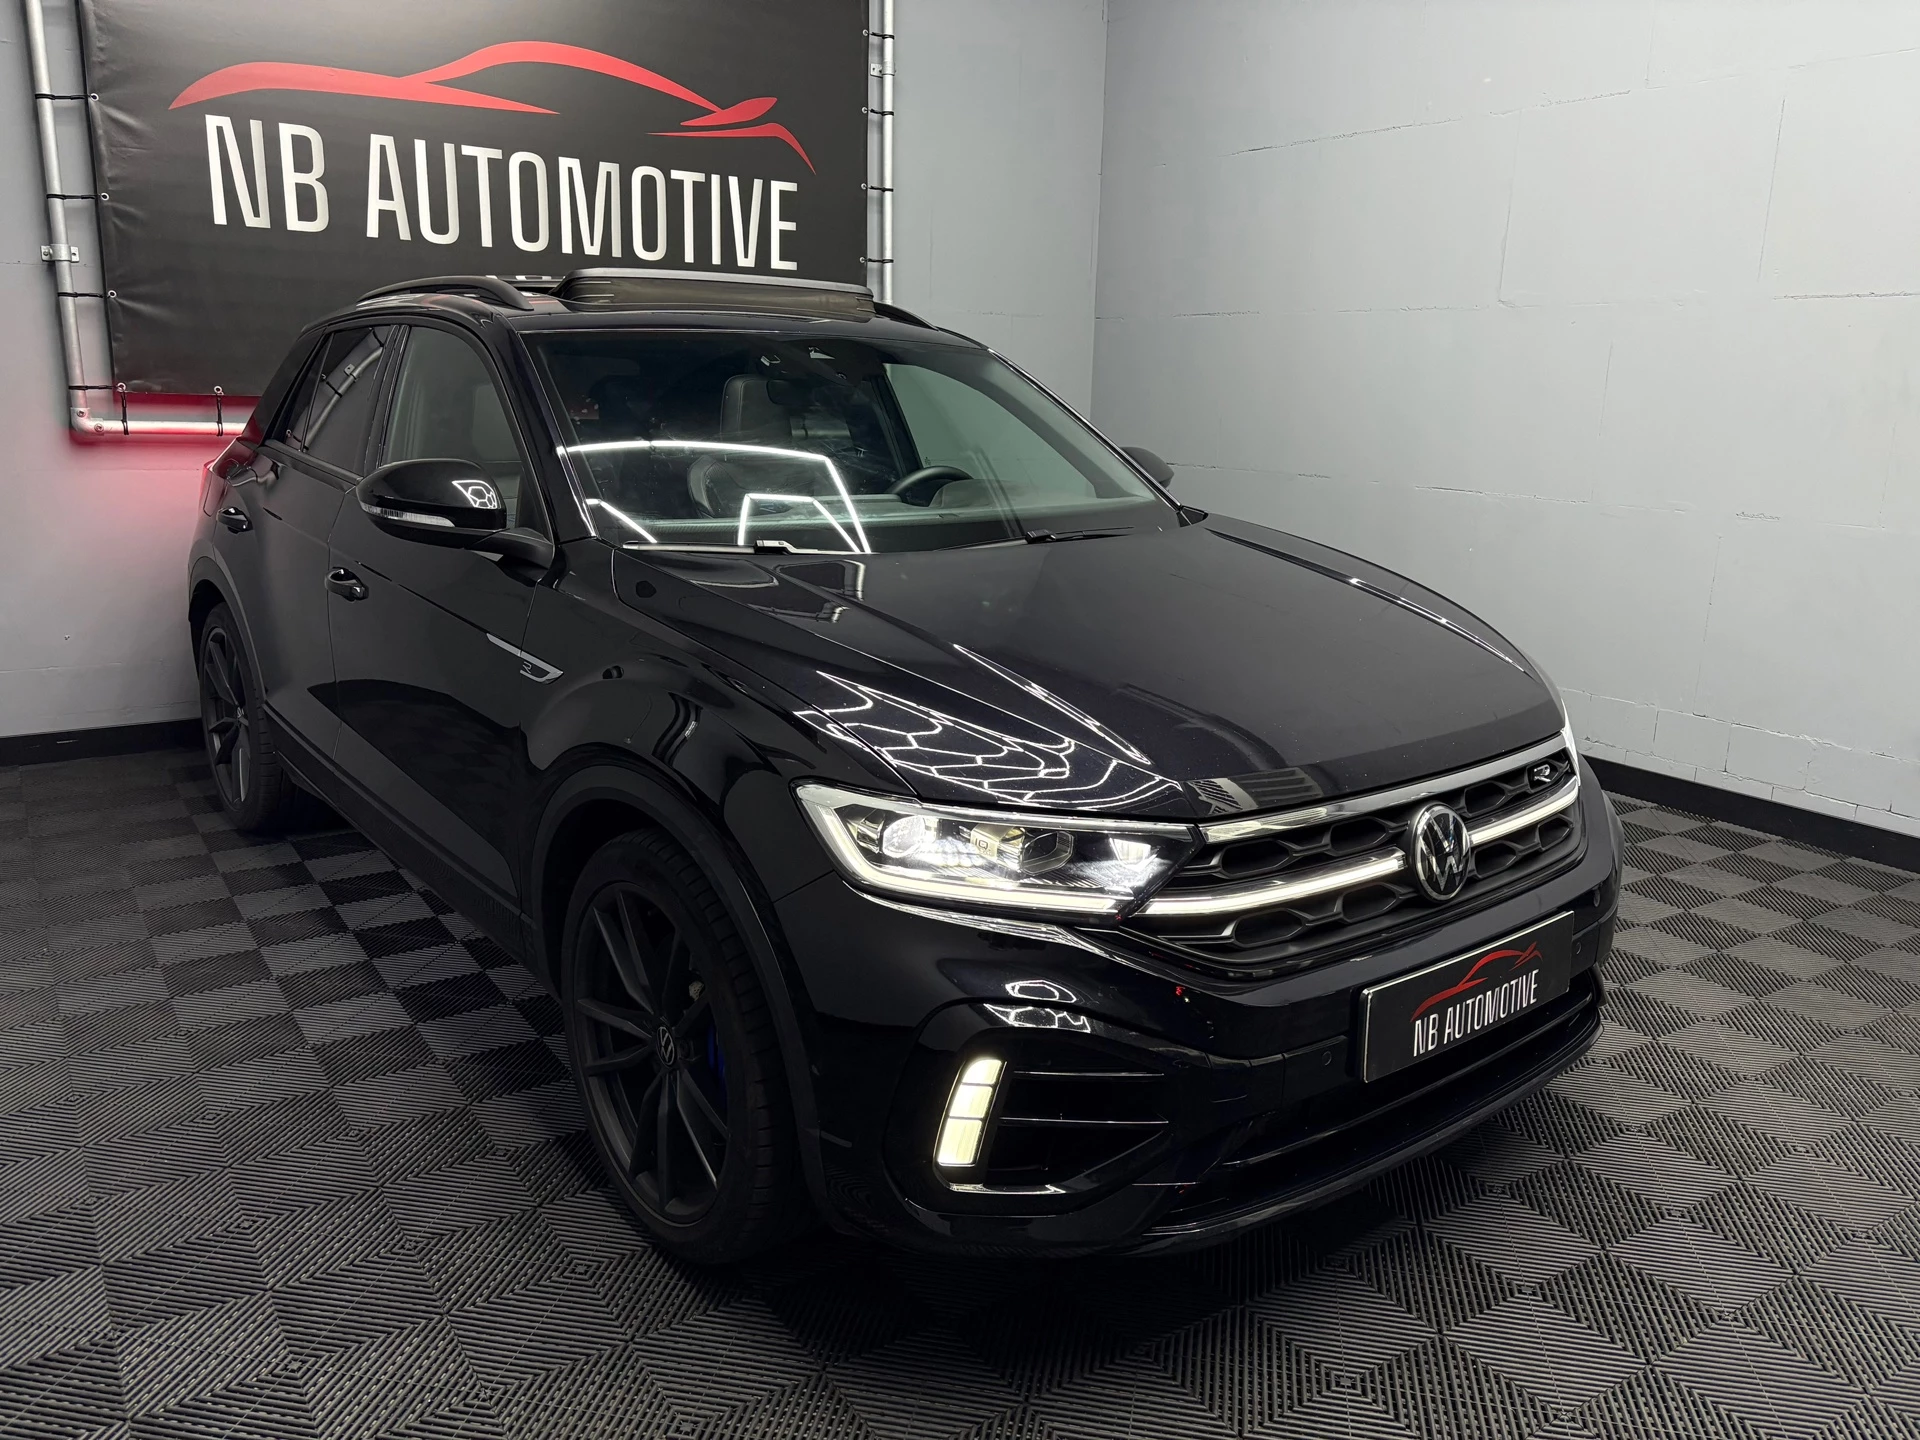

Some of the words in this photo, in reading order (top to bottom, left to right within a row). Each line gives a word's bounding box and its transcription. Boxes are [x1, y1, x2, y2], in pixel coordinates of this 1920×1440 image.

[205, 114, 329, 232] NB
[367, 134, 798, 271] AUTOMOTIVE
[1413, 1013, 1439, 1057] NB
[1443, 969, 1539, 1045] AUTOMOTIVE
